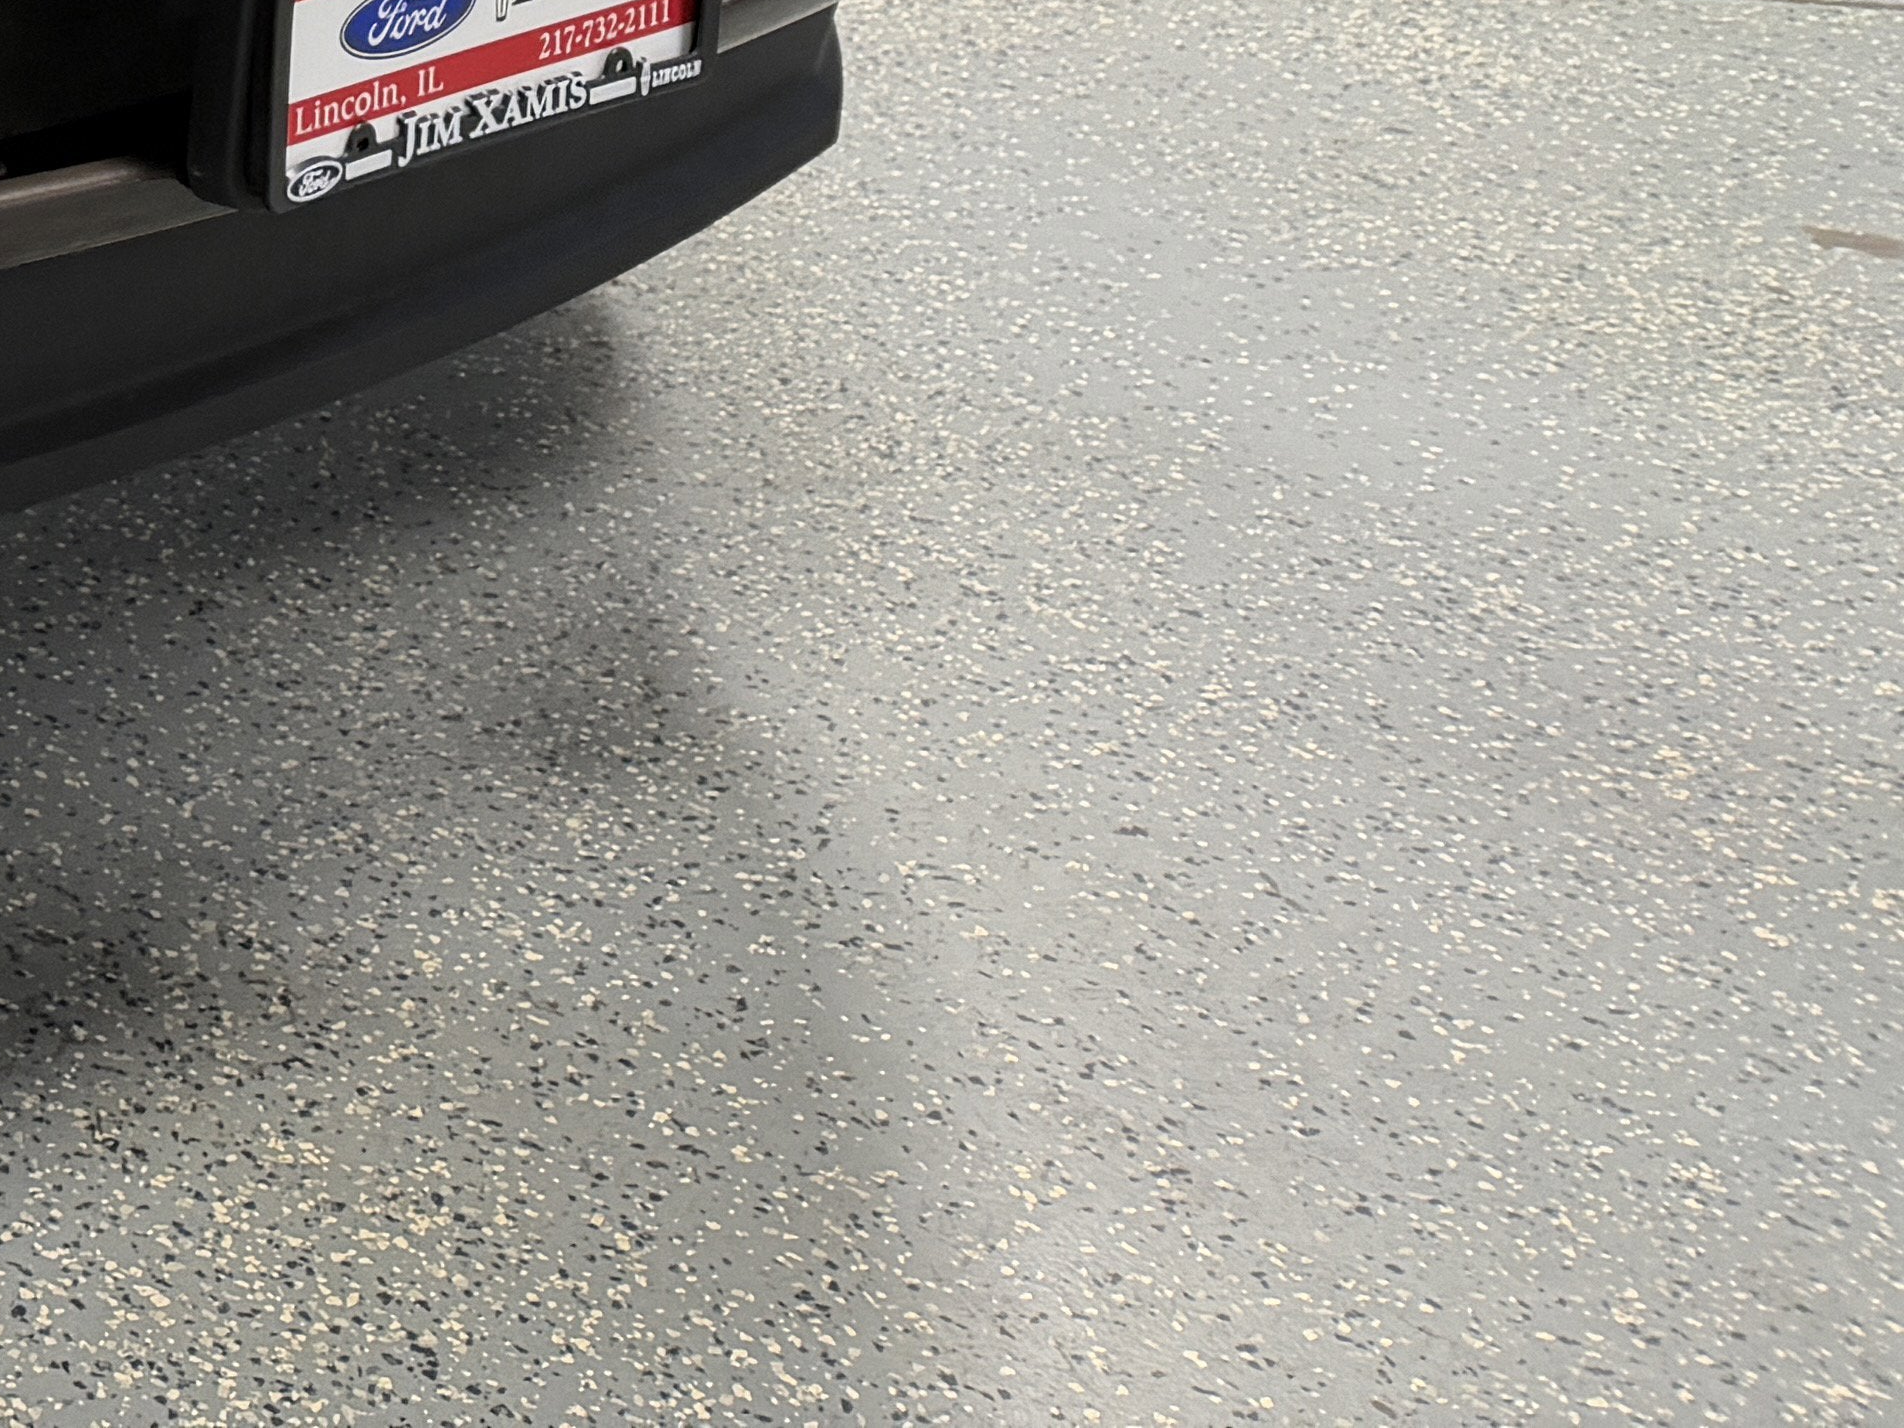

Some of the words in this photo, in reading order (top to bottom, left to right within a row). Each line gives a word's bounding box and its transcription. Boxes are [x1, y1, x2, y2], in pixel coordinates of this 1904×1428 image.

[652, 59, 702, 88] LINCOLN
[295, 80, 408, 135] Lincoln,
[417, 66, 445, 96] IL
[397, 111, 464, 168] JIM
[469, 76, 588, 139] XAMIS
[298, 168, 332, 197] Ford
